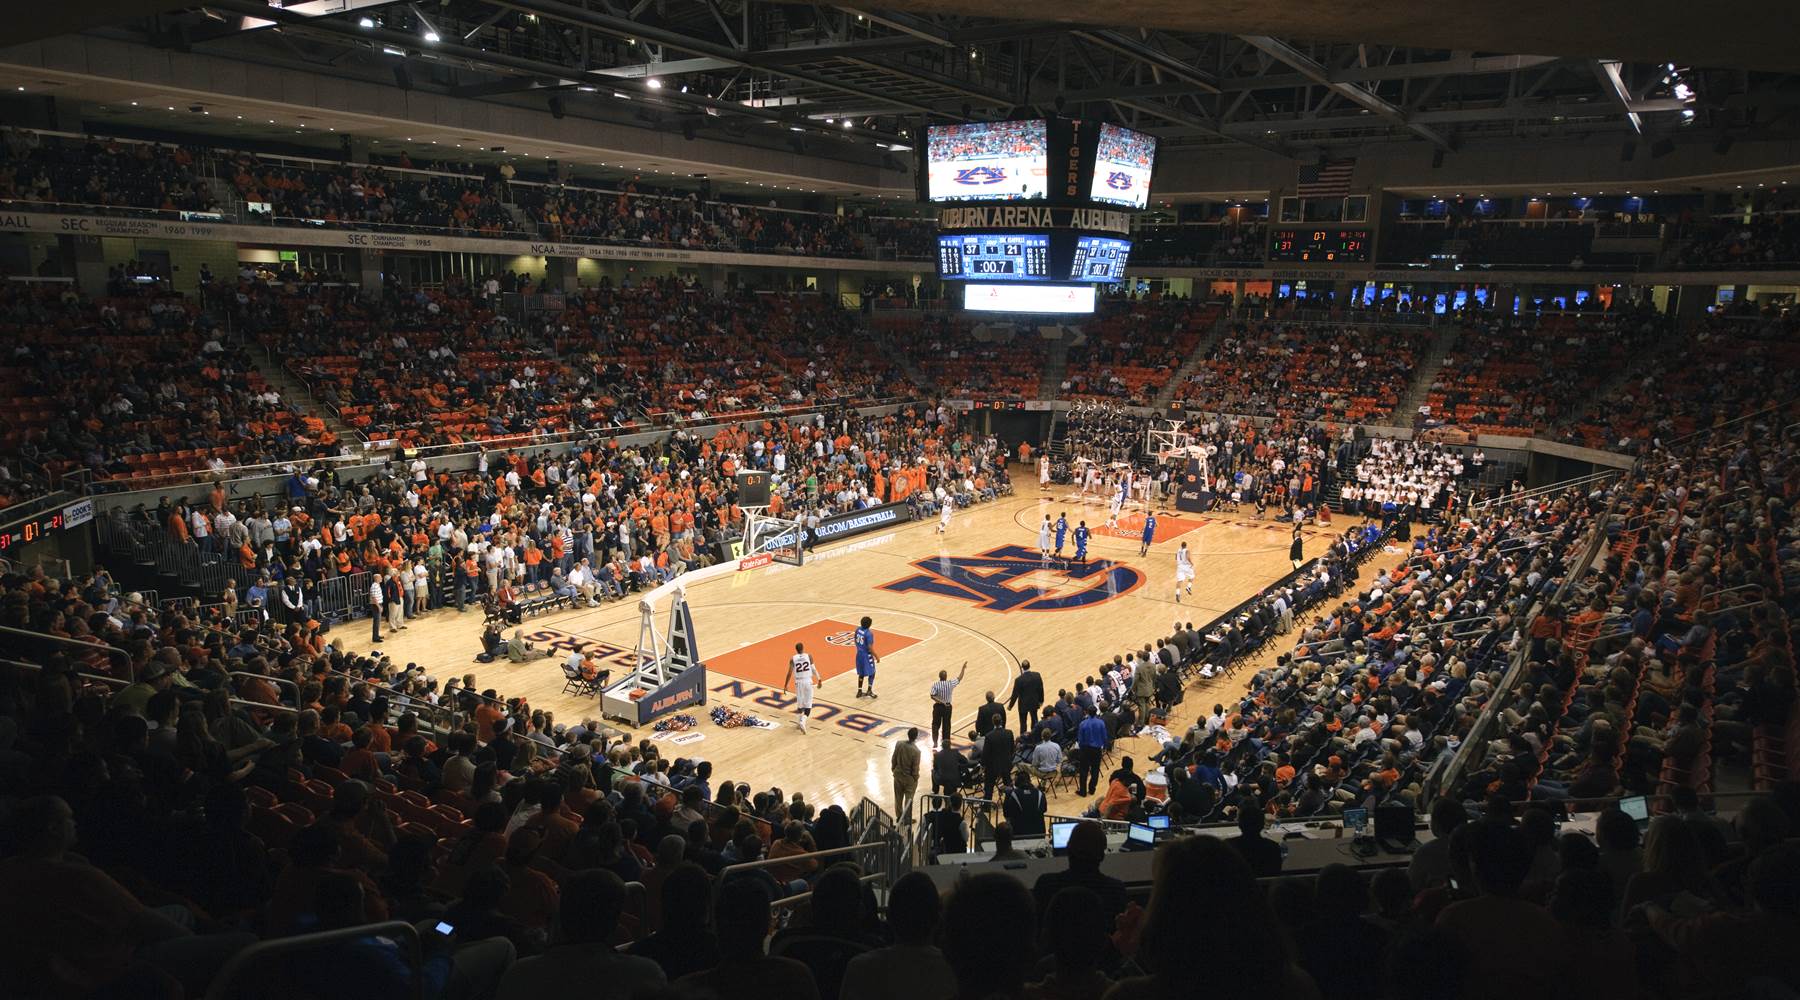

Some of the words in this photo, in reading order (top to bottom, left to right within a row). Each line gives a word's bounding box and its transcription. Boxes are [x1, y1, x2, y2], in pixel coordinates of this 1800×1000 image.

[1066, 120, 1082, 196] TIGERS
[942, 207, 988, 228] UBURN
[991, 206, 1054, 228] ARENA
[60, 218, 89, 232] SEC
[348, 234, 368, 245] SEC
[1280, 241, 1292, 250] 37
[1348, 241, 1360, 250] 21
[531, 244, 556, 255] NCAA
[966, 245, 977, 255] 37
[1007, 245, 1018, 255] 21
[980, 261, 1006, 273] :00.7
[52, 514, 63, 529] 21
[0, 534, 11, 549] 37
[795, 661, 810, 673] 22
[651, 688, 693, 714] AUBURN
